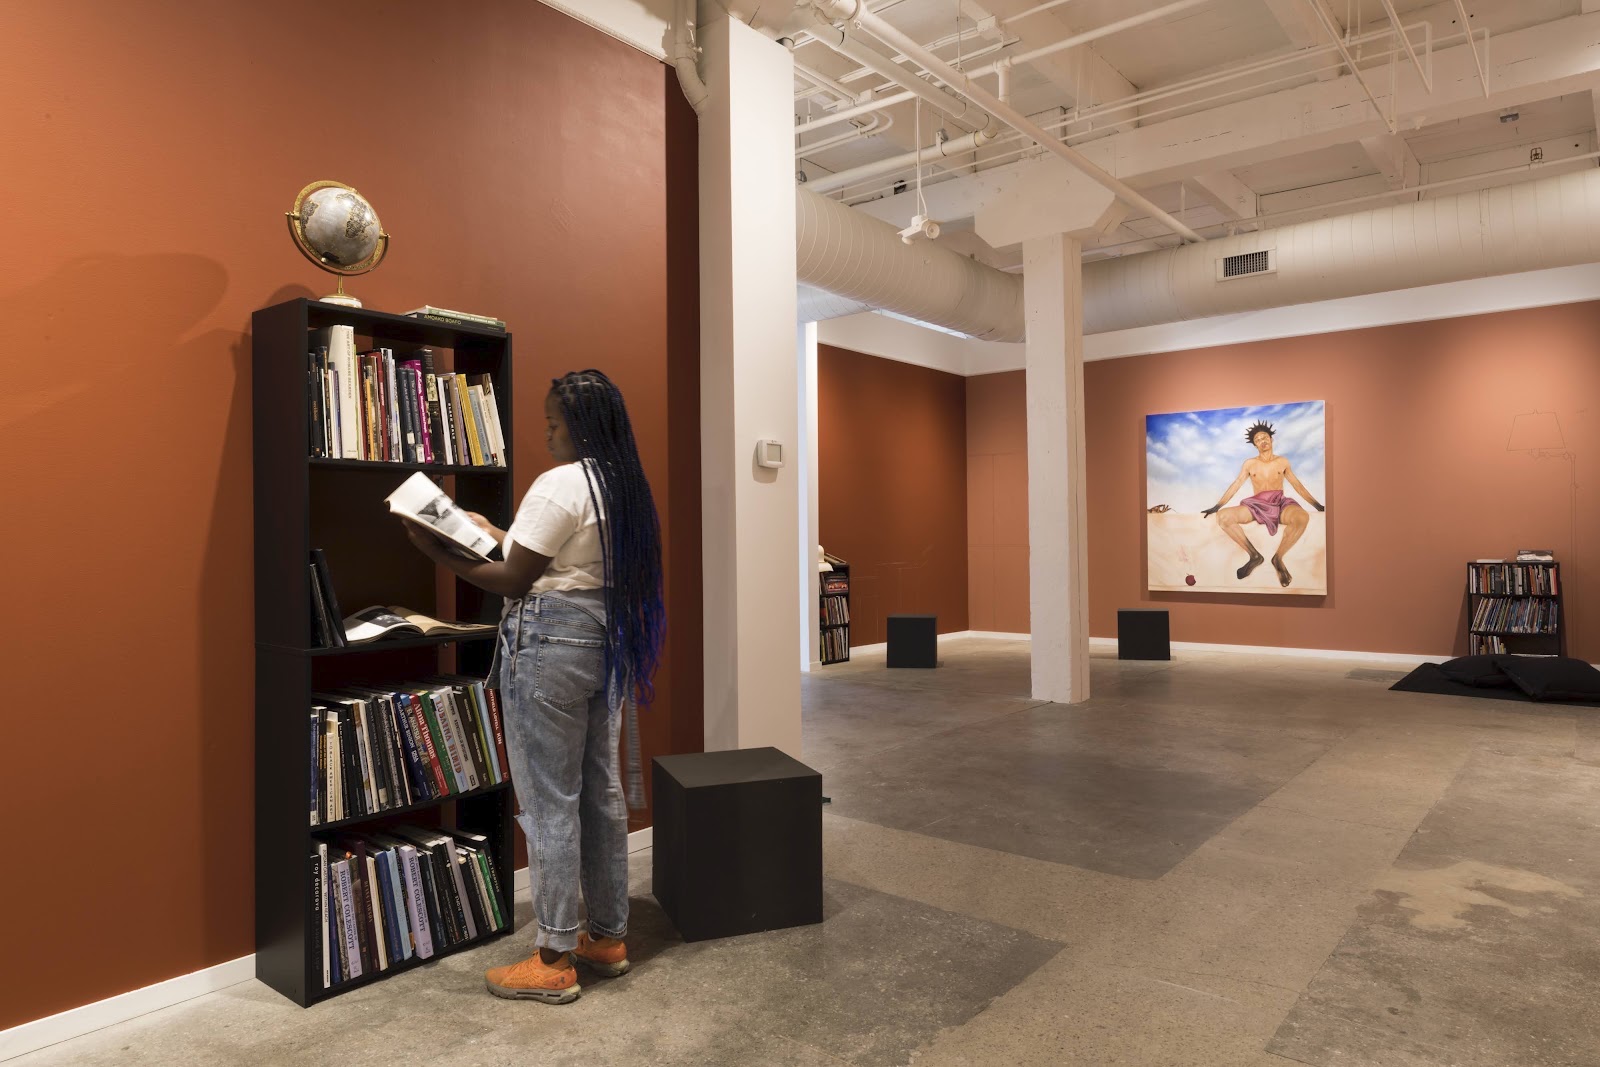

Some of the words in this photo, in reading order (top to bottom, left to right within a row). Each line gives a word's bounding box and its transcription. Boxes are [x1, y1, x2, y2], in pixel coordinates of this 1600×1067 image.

[413, 702, 425, 724] Alma
[421, 724, 437, 760] Thomas
[435, 700, 451, 742] LUBAINA
[447, 744, 463, 774] HIMID
[340, 870, 349, 902] ROBERT
[409, 856, 418, 887] ROBERT
[414, 888, 426, 932] COLESCOTT
[344, 904, 355, 950] COLESCOTT
